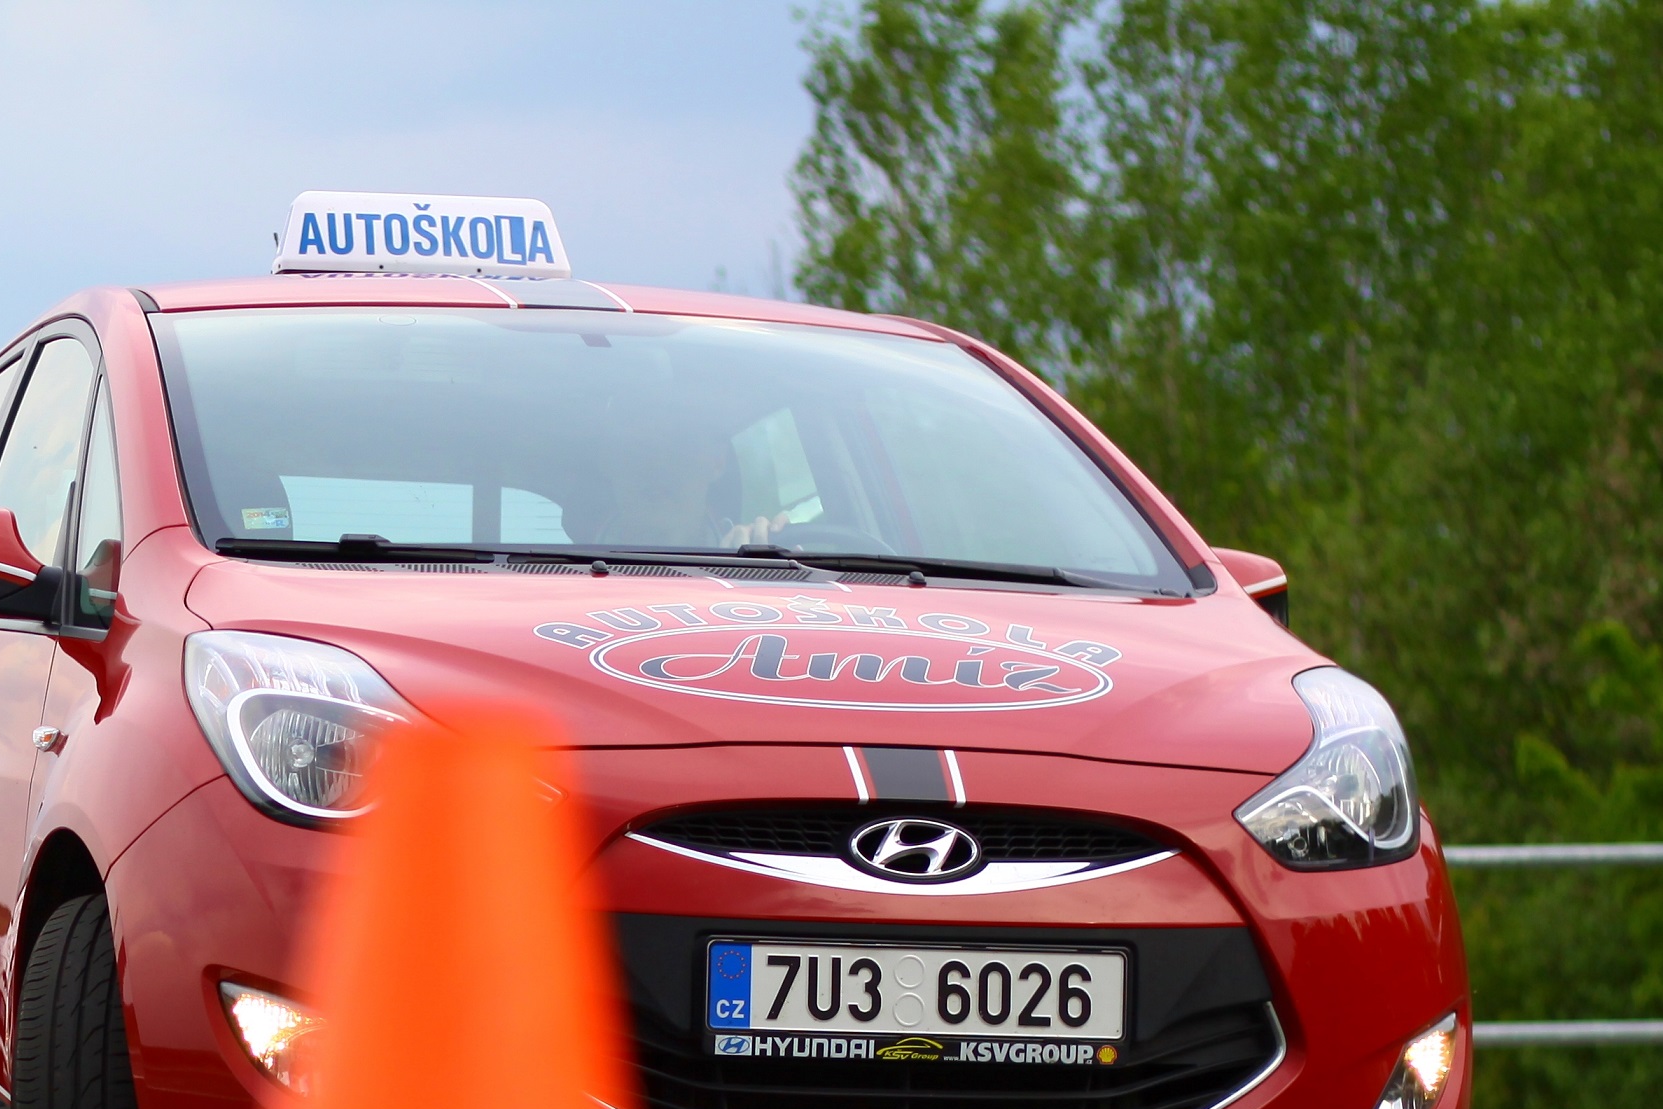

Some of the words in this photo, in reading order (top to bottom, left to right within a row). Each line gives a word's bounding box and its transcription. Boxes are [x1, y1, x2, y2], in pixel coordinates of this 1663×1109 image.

[298, 203, 555, 266] AUTOŠKOLA
[533, 595, 1122, 667] AUTOŠKOLA
[716, 999, 745, 1019] CZ
[766, 954, 884, 1022] 7U3
[938, 960, 1094, 1028] 6026
[755, 1036, 875, 1059] HYUNDAI
[911, 1052, 939, 1061] Group
